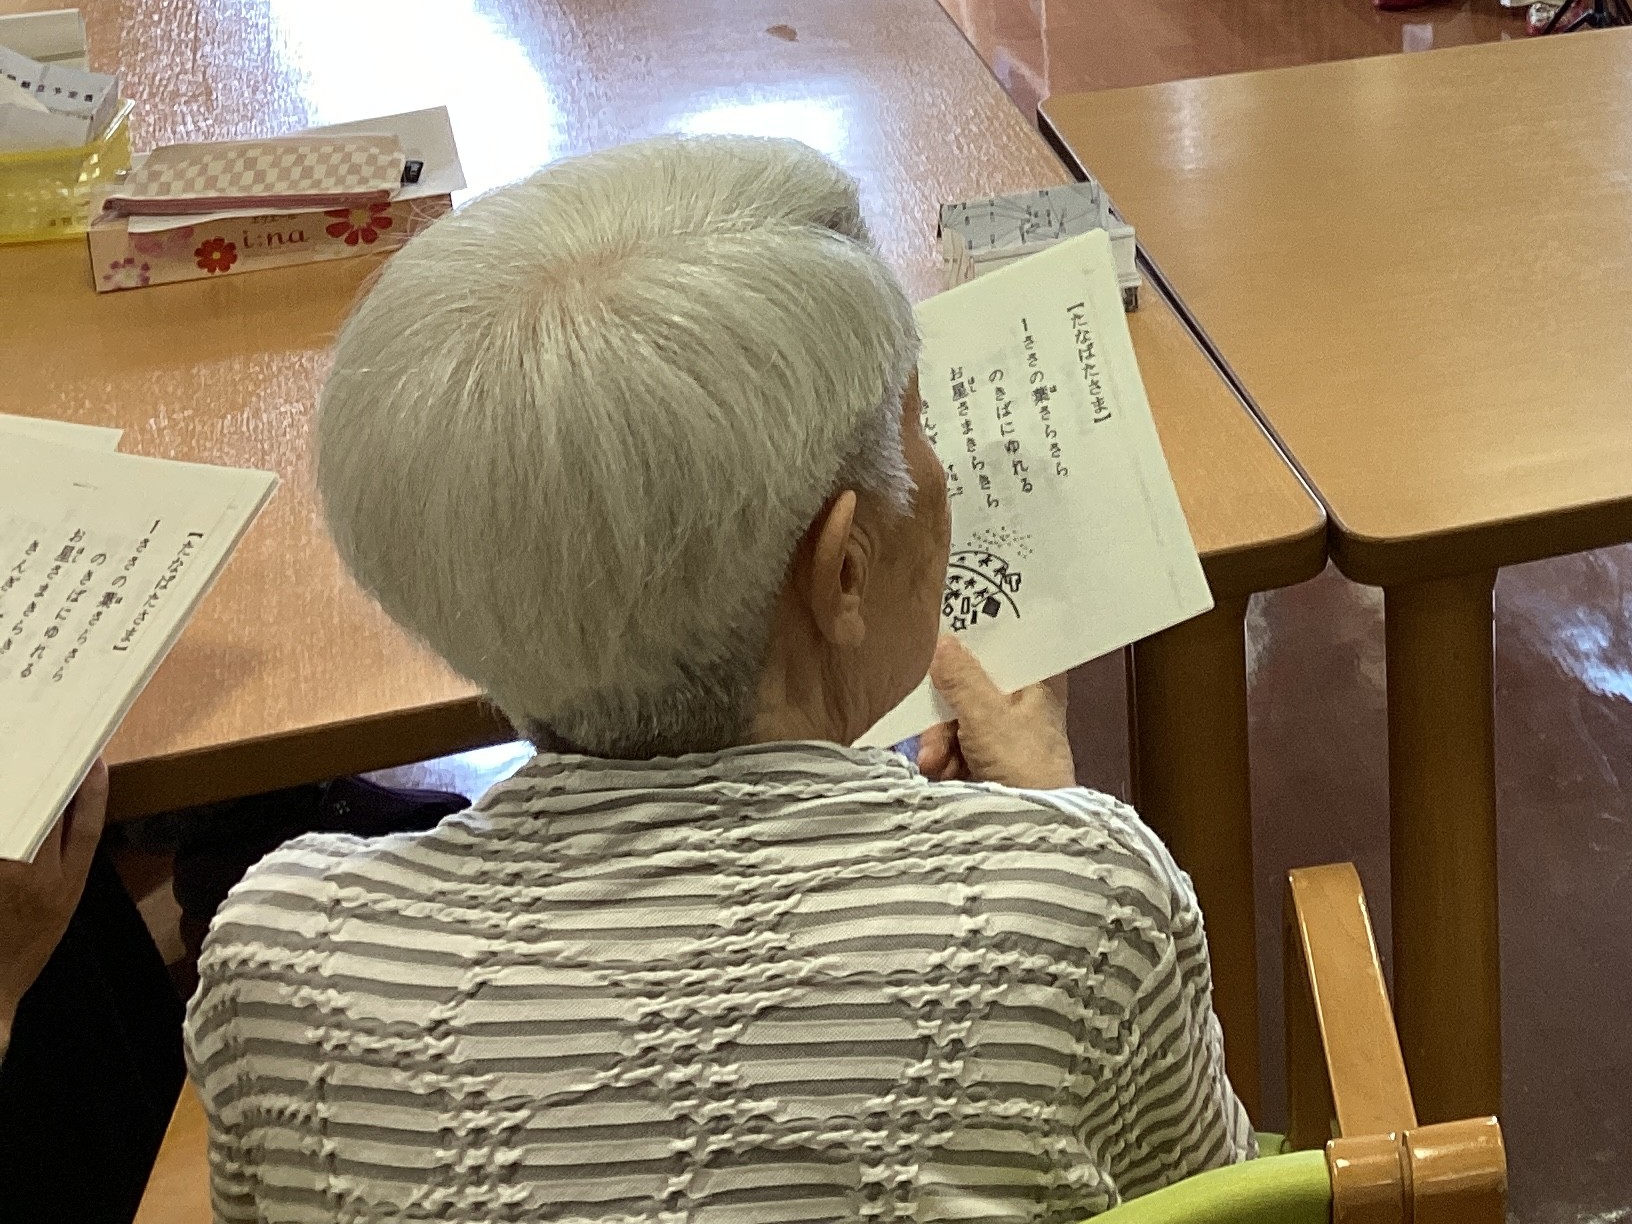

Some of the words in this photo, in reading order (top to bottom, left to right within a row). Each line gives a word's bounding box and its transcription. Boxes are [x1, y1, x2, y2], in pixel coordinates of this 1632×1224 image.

[988, 368, 1033, 495] のきばにゆれる
[20, 552, 107, 679] のきばにゆれる
